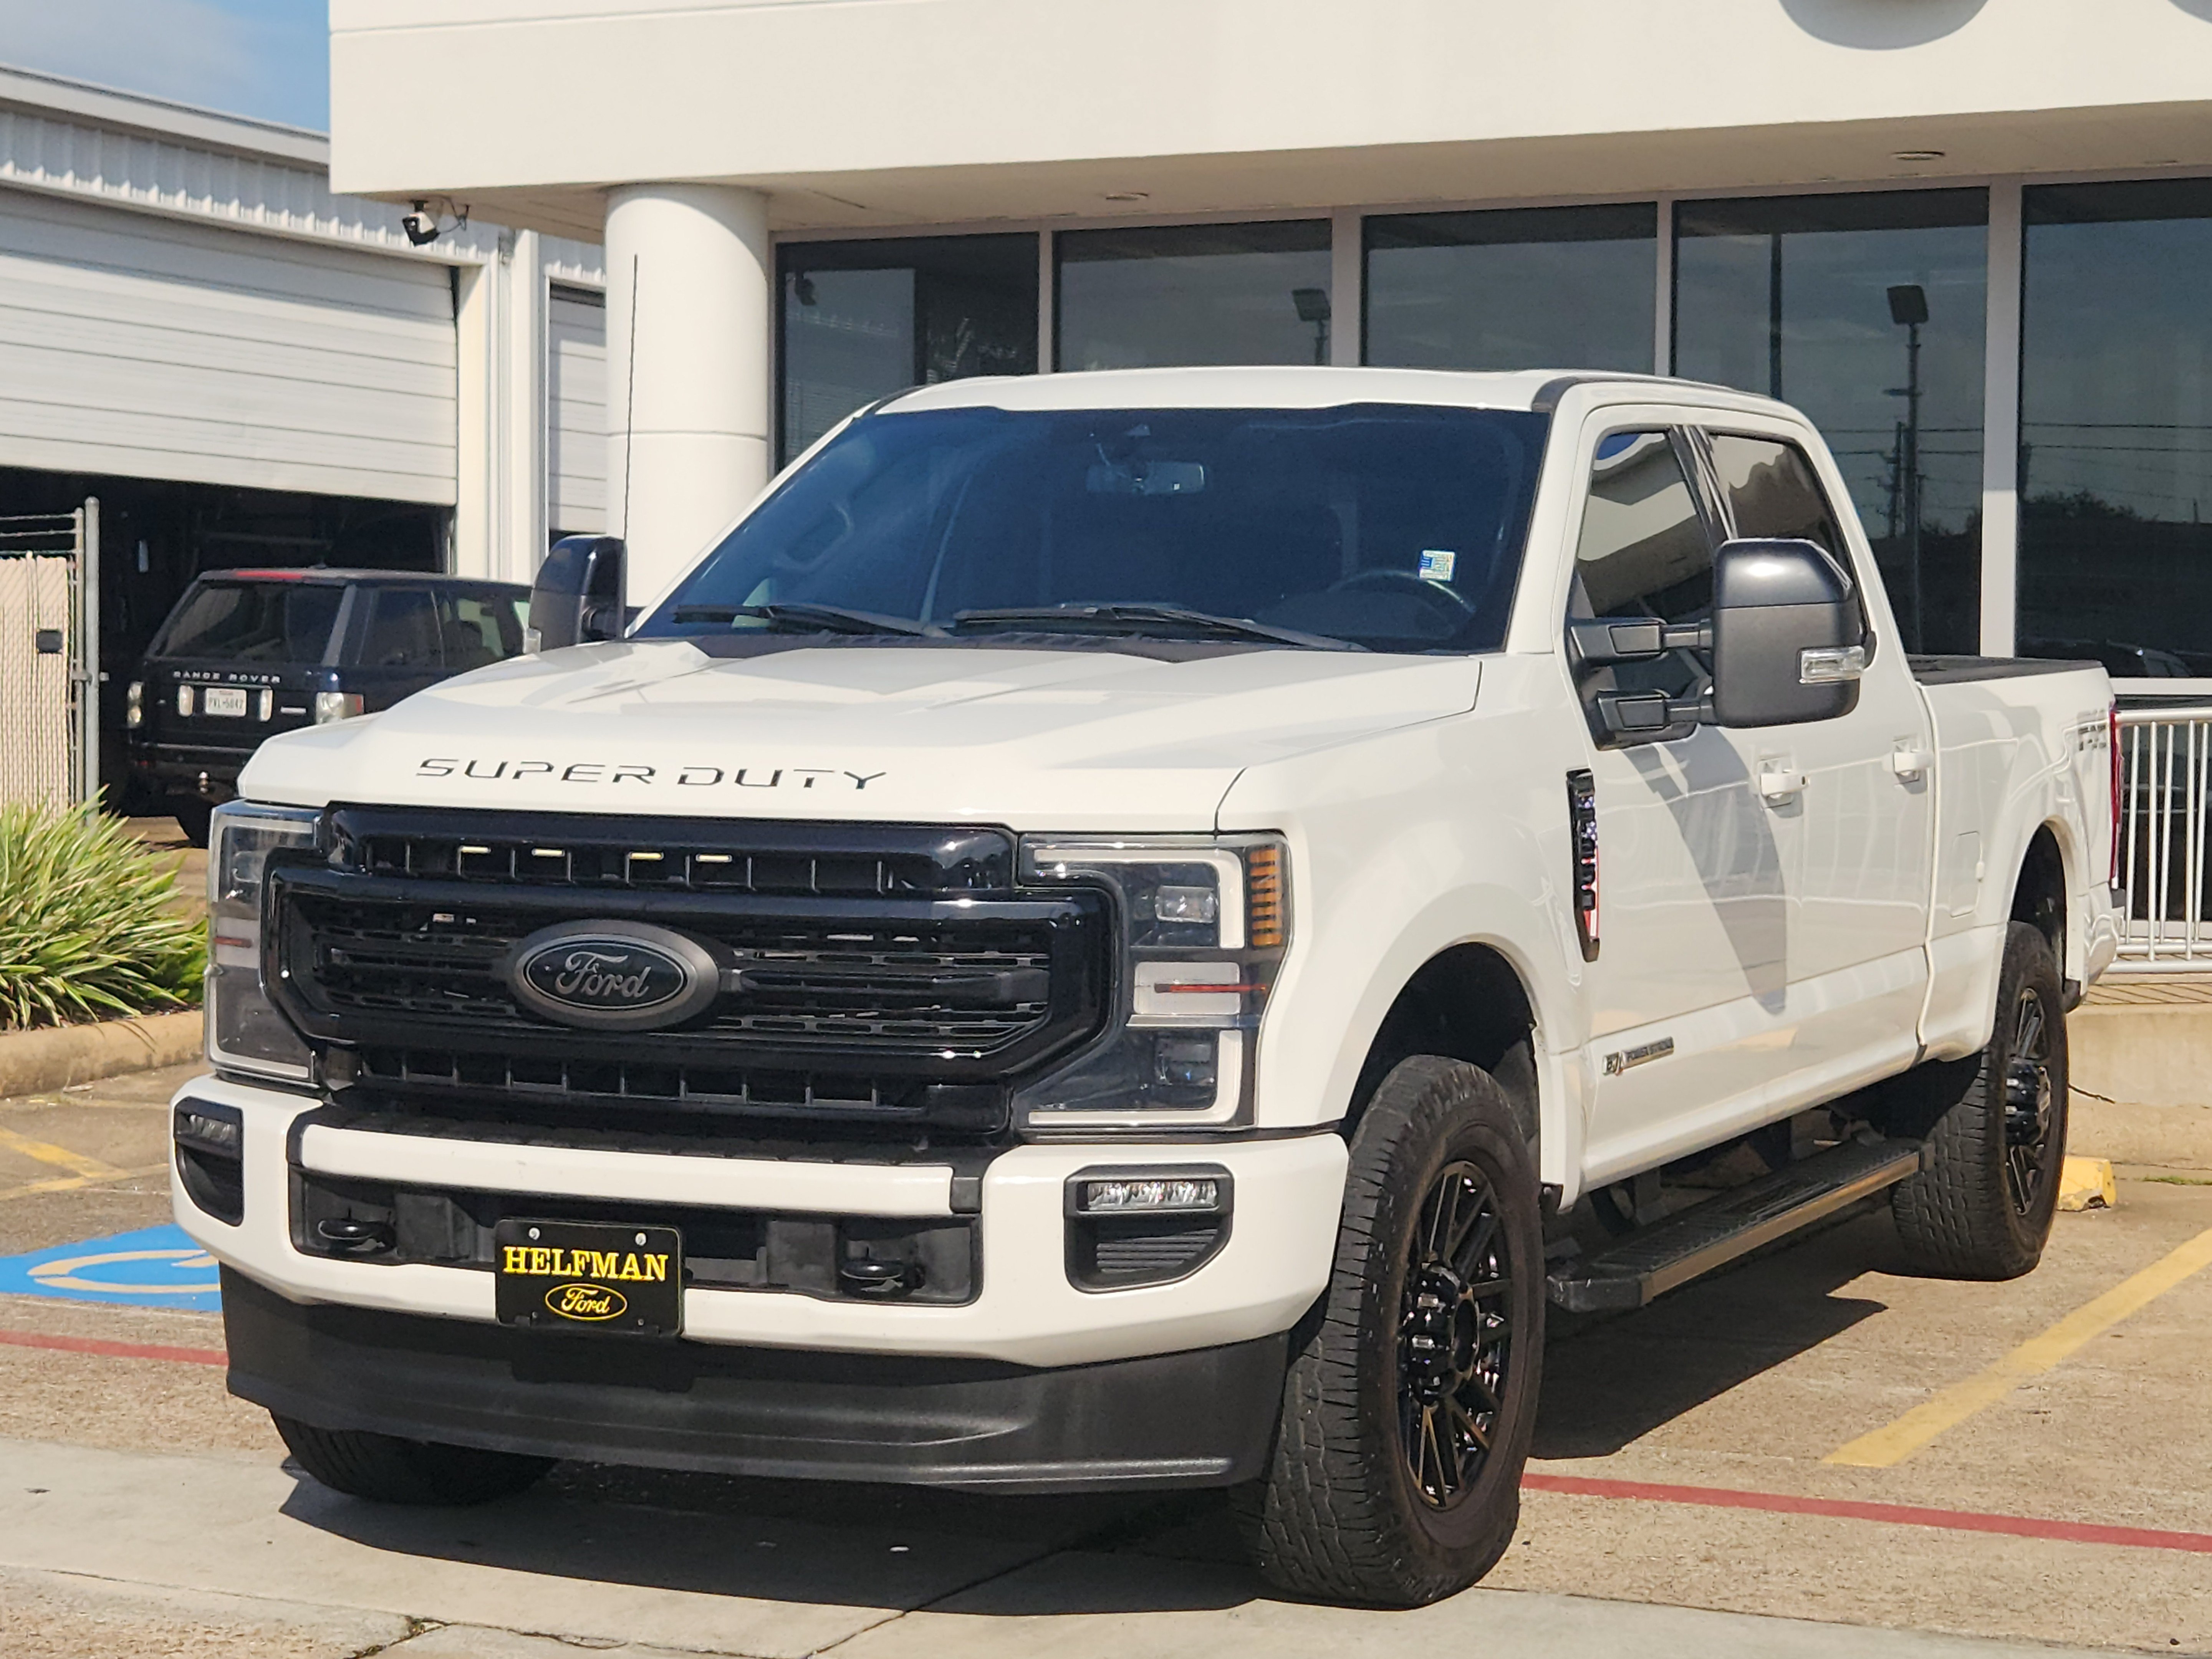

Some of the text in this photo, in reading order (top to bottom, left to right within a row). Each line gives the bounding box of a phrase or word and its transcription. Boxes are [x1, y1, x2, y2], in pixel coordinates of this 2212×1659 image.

[174, 671, 281, 684] RANGE ROVER
[416, 758, 887, 790] SUPER DUTY
[555, 951, 651, 998] Ford
[503, 1246, 669, 1282] HELFMAN
[561, 1287, 612, 1314] Ford
